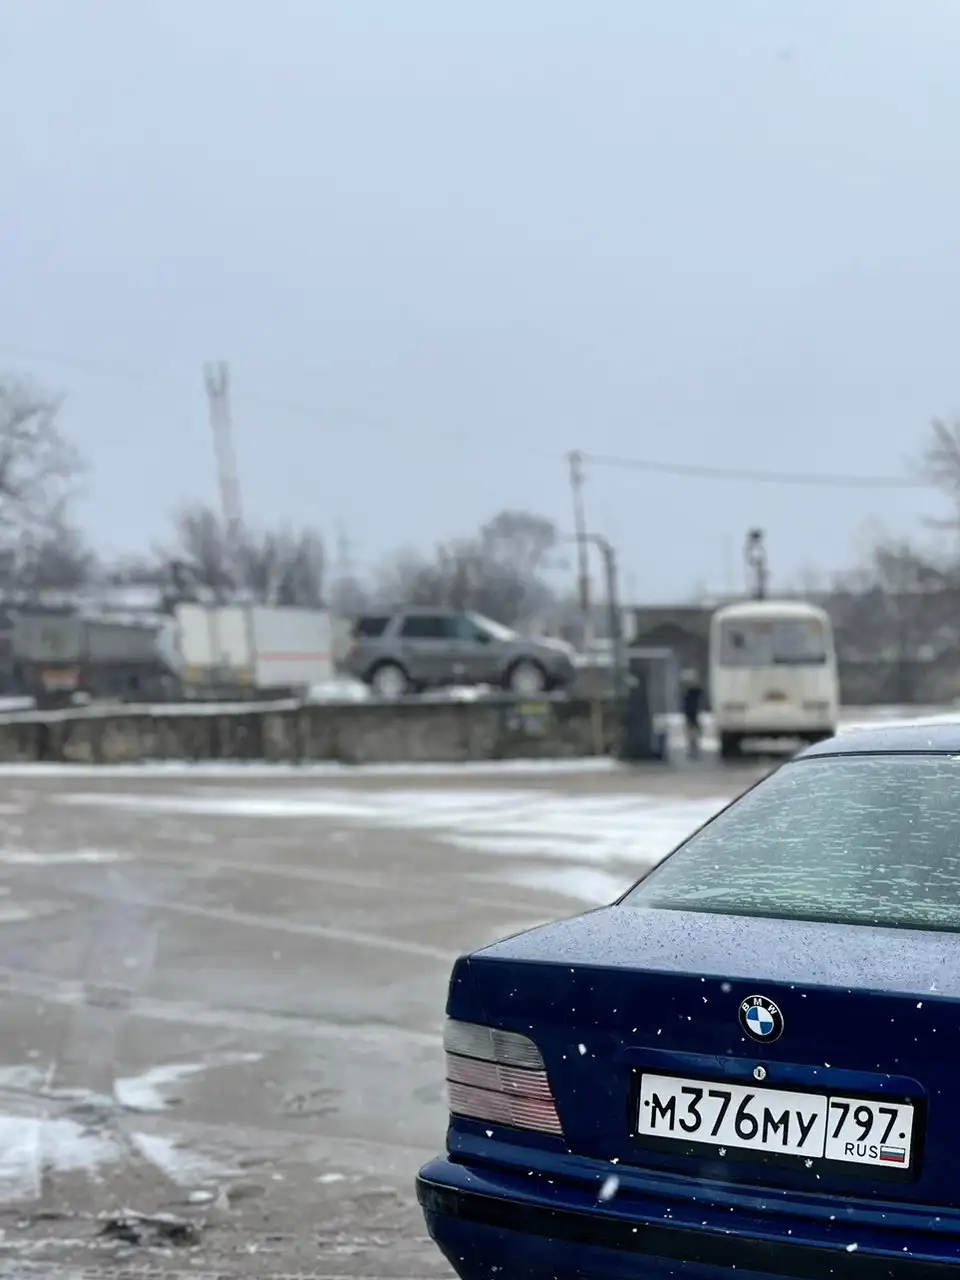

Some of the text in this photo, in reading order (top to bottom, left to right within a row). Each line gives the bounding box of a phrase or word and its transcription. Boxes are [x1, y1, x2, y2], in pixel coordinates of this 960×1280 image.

[742, 997, 777, 1015] BMW
[831, 1102, 898, 1144] 797
[844, 1142, 878, 1159] RUS
